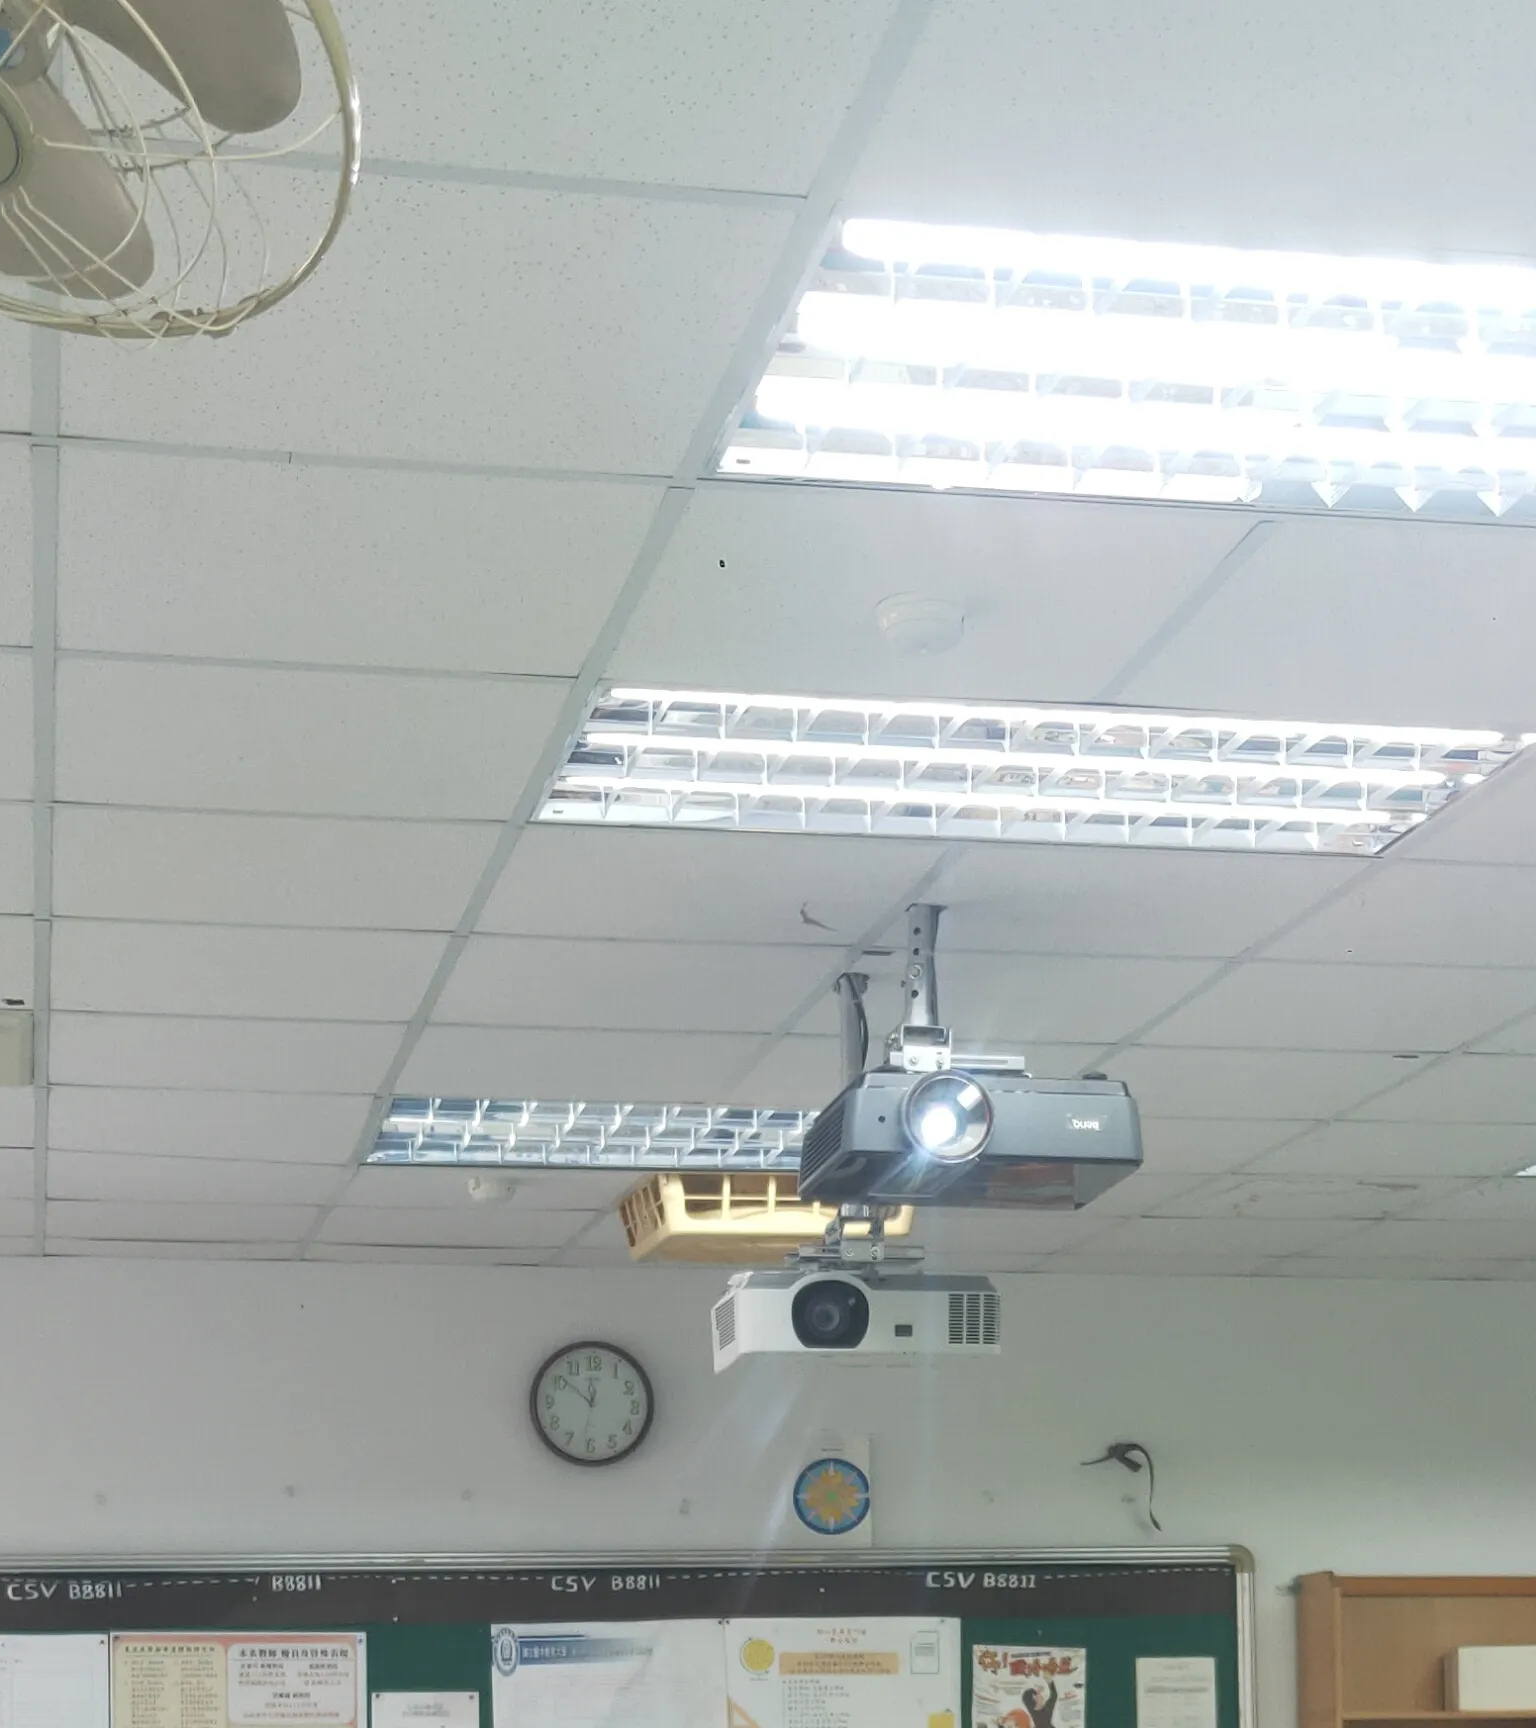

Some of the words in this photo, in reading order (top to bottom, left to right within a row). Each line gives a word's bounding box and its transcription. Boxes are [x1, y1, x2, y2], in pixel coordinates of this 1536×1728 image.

[567, 1361, 580, 1376] 11
[585, 1356, 602, 1371] 12
[613, 1362, 619, 1379] 1
[622, 1420, 633, 1435] 4
[565, 1432, 575, 1446] 7
[586, 1437, 596, 1453] 6
[607, 1434, 618, 1449] 5
[550, 1575, 597, 1592] CSV
[925, 1571, 976, 1589] CSV
[6, 1581, 58, 1601] CSV
